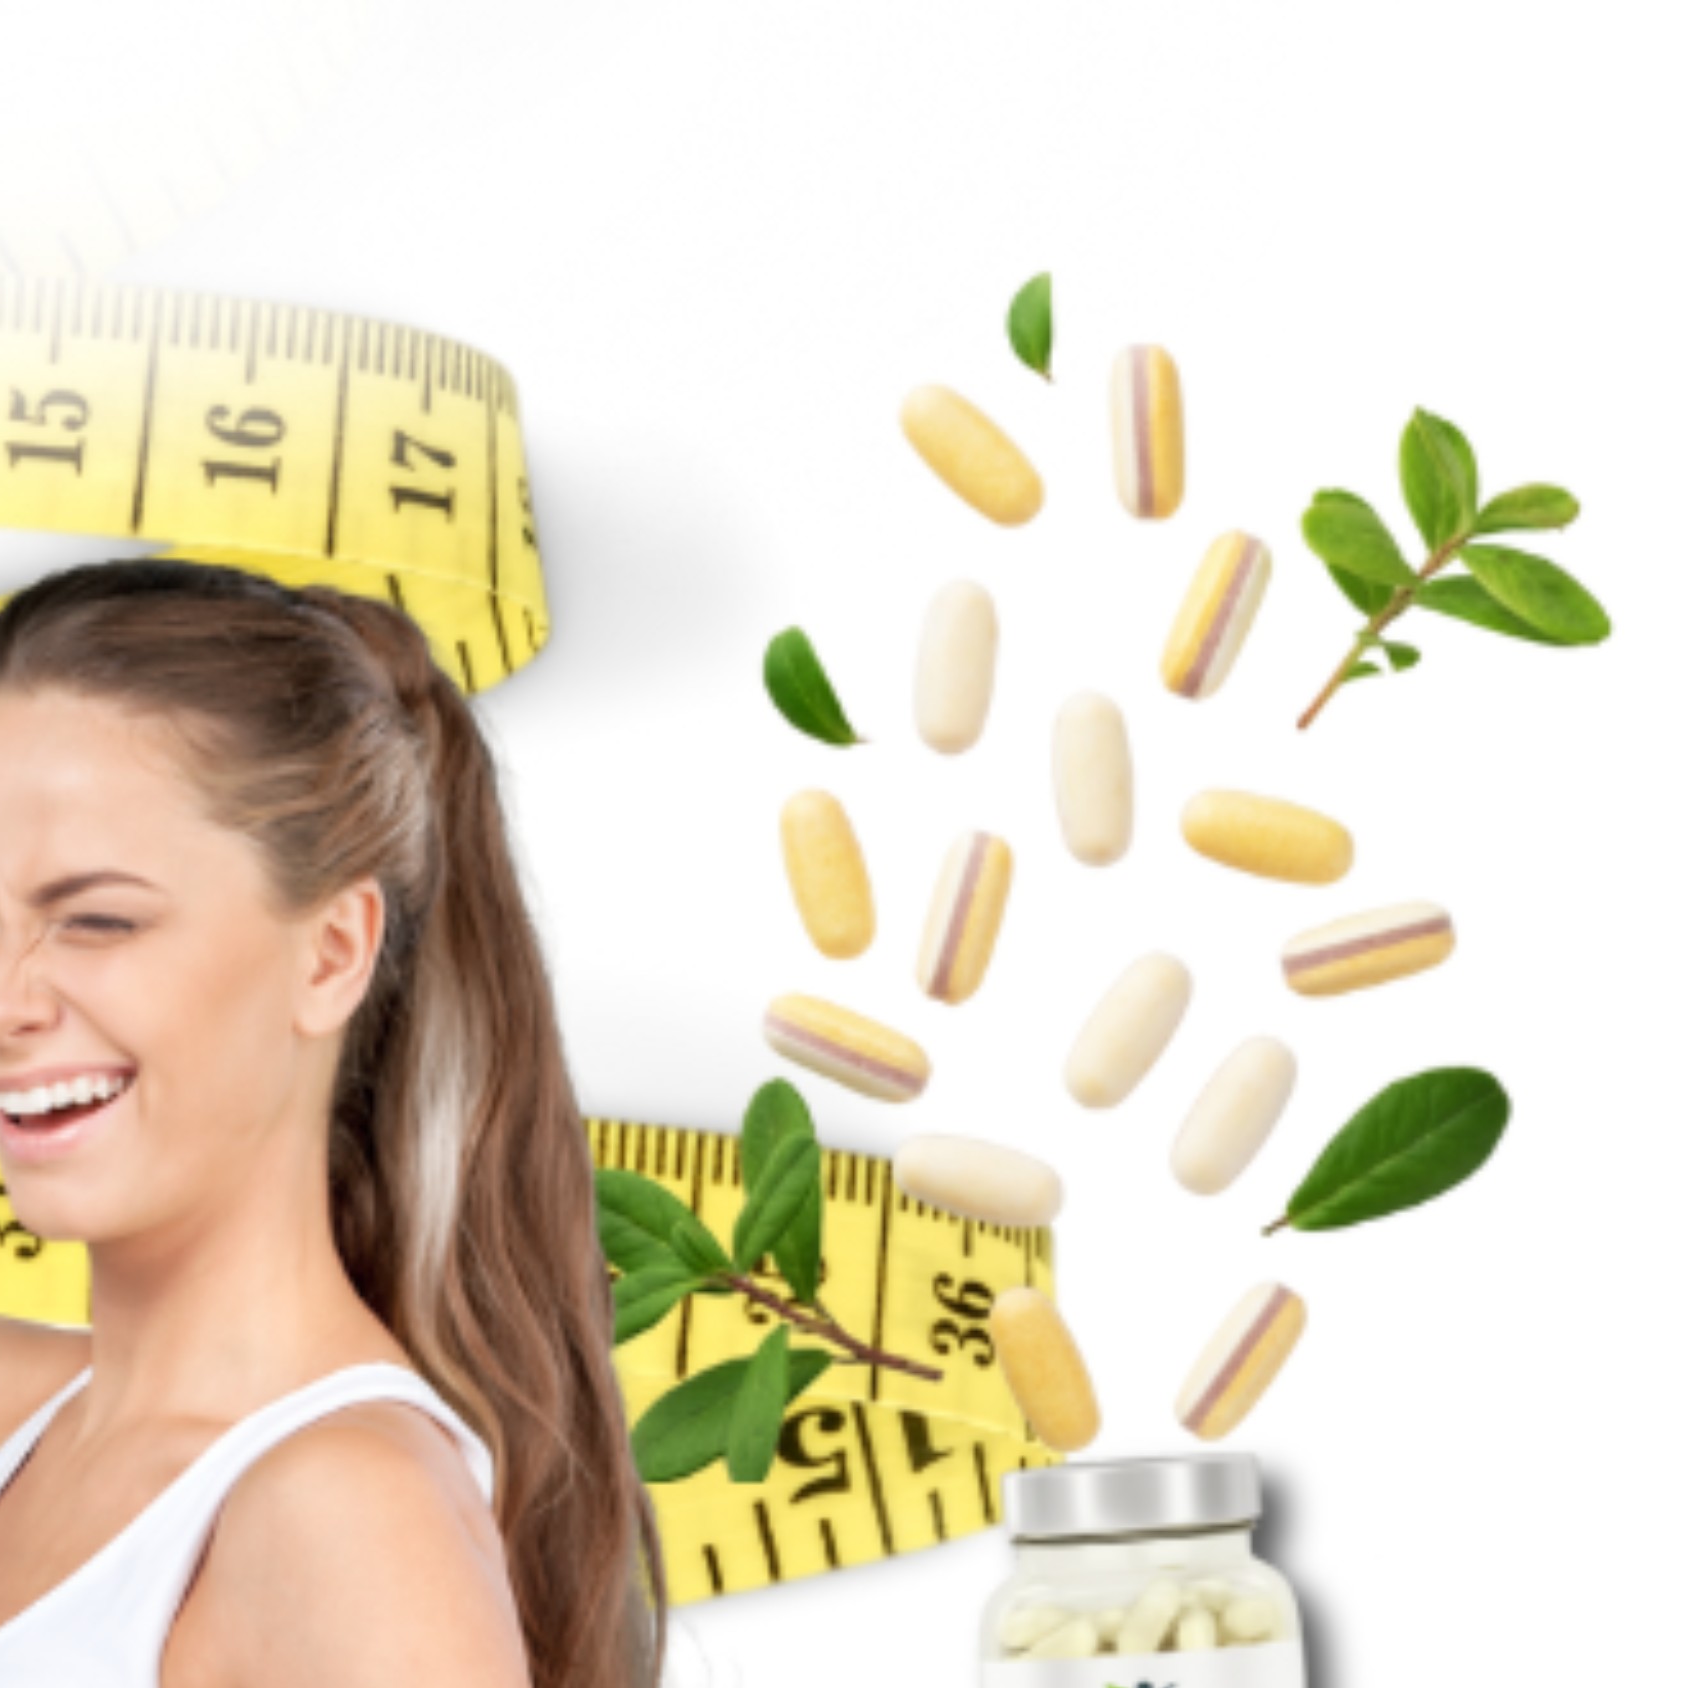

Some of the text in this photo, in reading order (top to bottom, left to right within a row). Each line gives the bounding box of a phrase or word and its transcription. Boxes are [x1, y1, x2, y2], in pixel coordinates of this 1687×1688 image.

[8, 388, 89, 476] 15
[205, 403, 287, 494] 16
[389, 430, 457, 522] 17
[929, 1273, 995, 1368] 36
